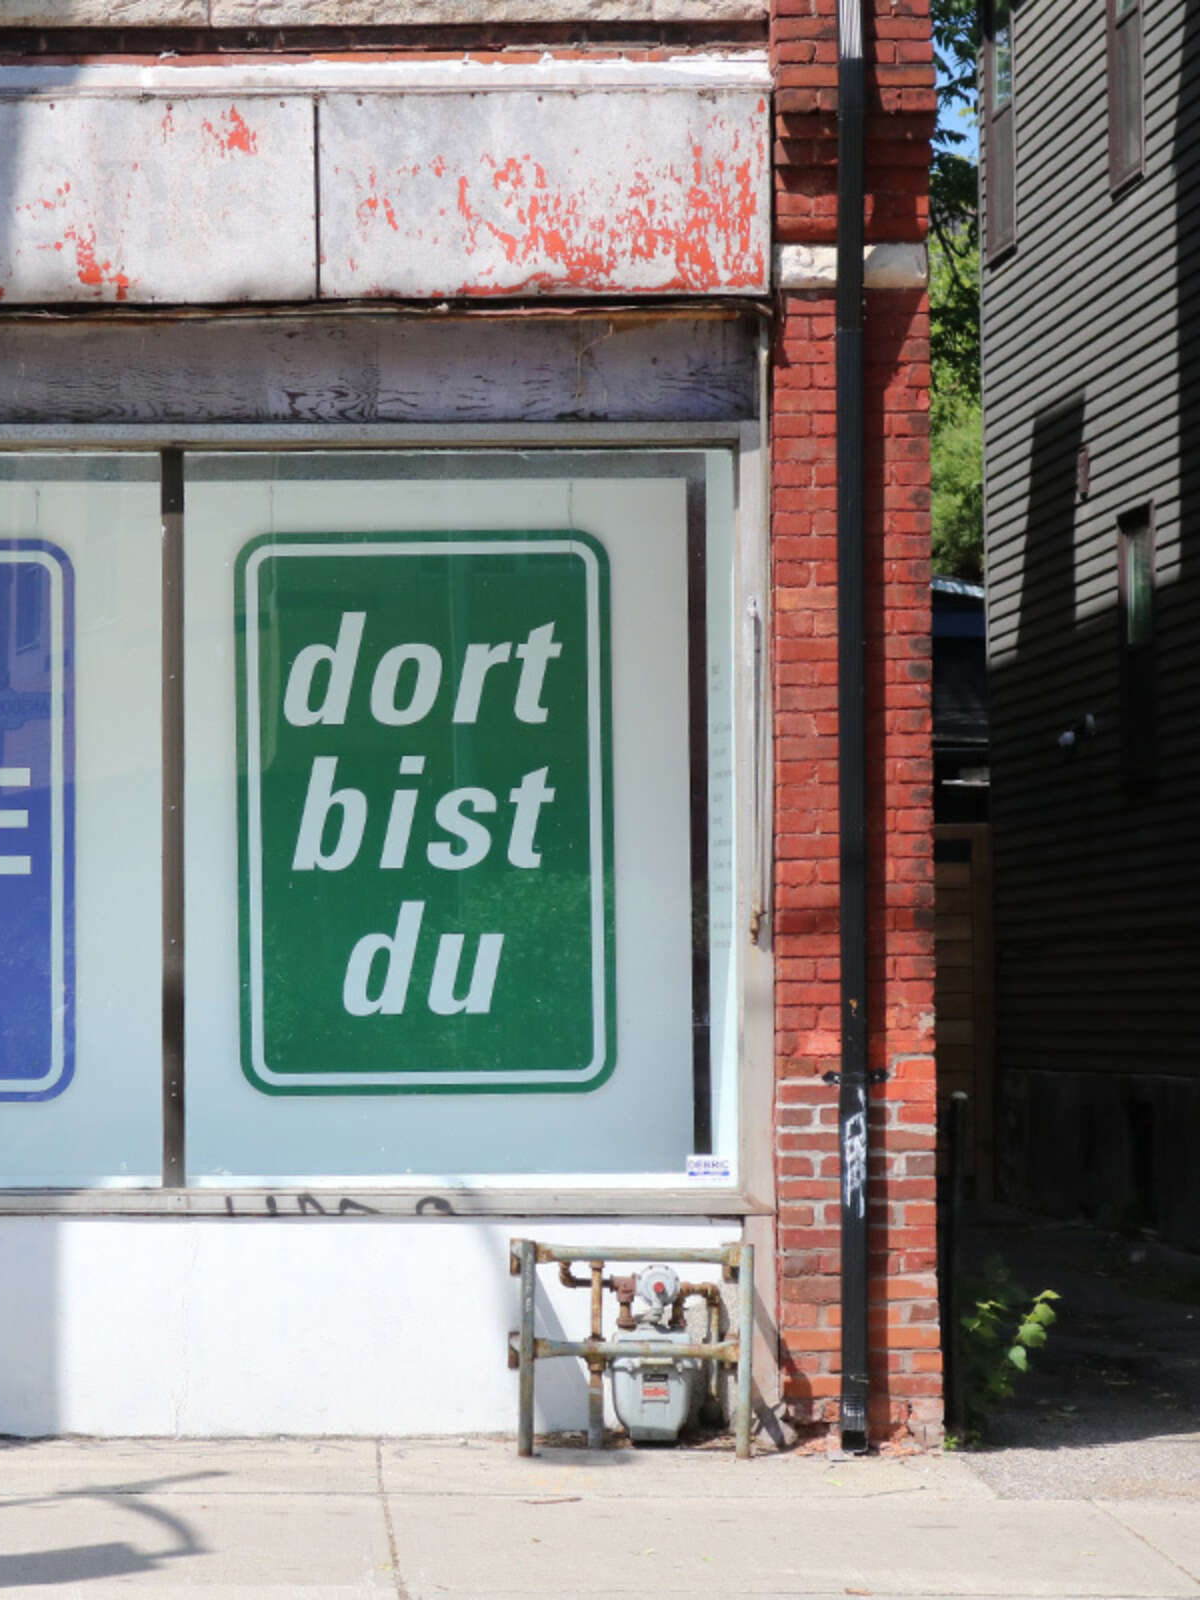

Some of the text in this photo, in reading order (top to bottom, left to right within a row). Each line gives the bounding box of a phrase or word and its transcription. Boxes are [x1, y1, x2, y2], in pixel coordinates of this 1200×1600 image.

[283, 611, 563, 727] dort
[292, 756, 556, 871] bist
[343, 900, 505, 1017] du
